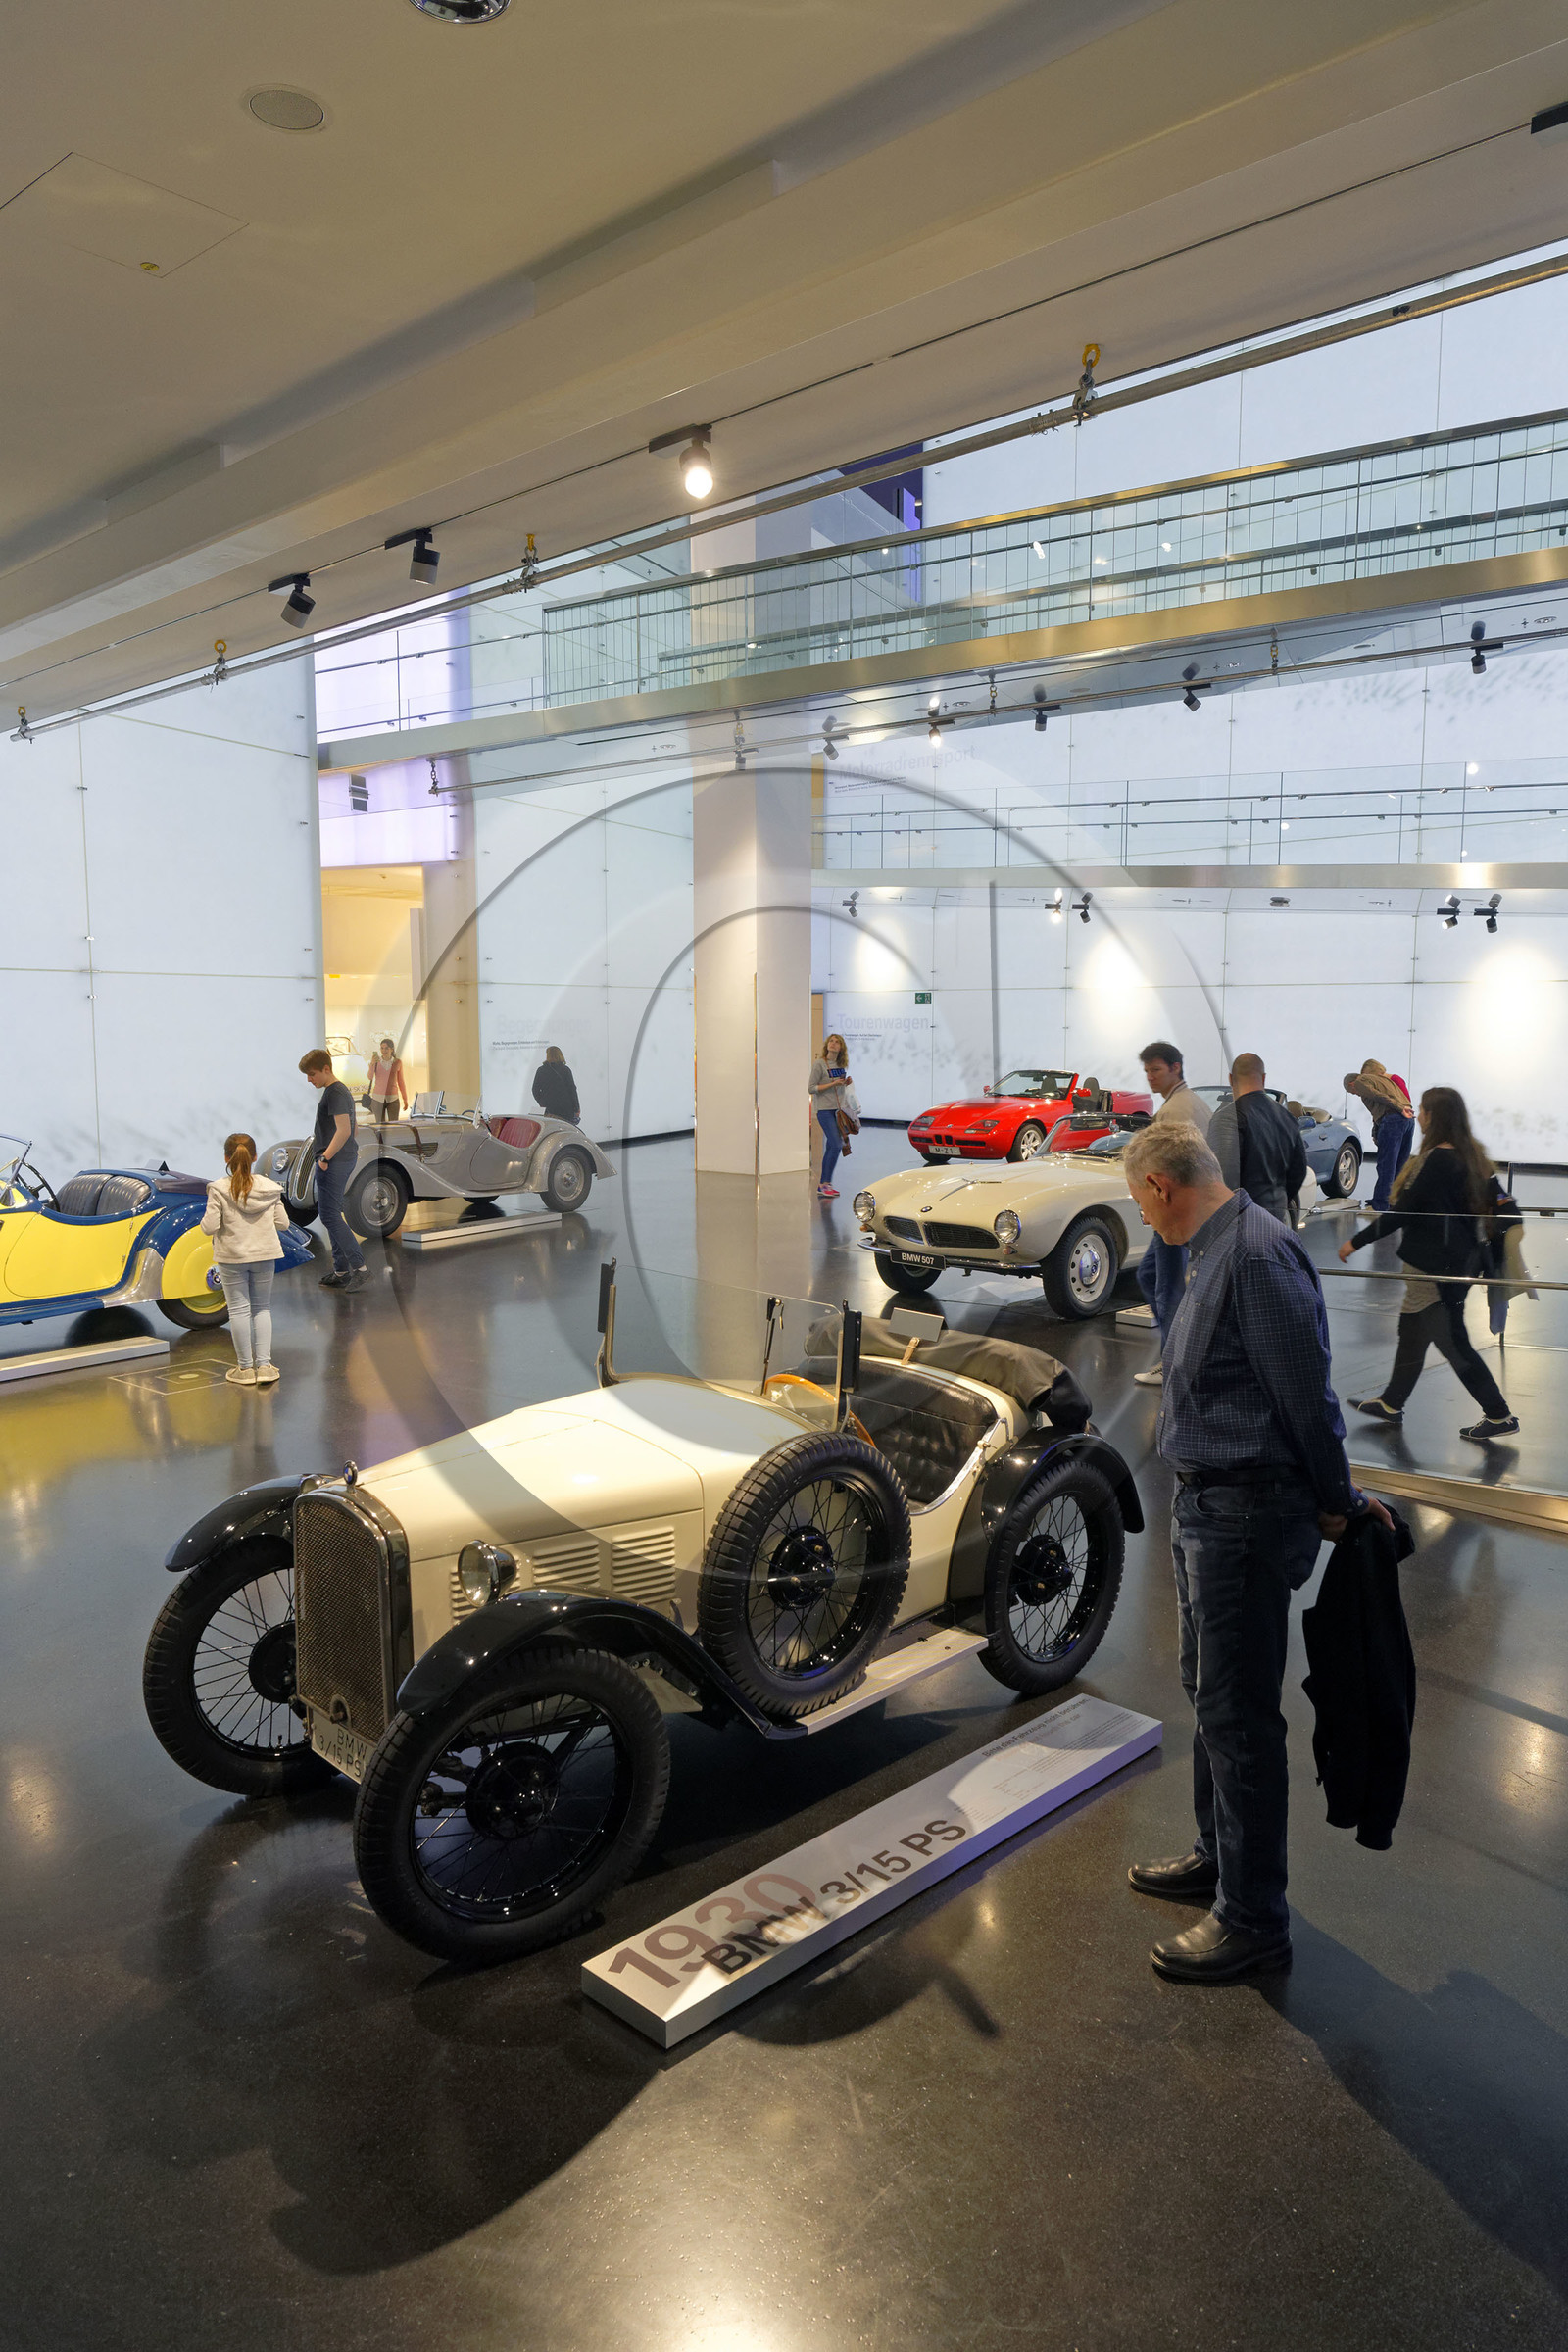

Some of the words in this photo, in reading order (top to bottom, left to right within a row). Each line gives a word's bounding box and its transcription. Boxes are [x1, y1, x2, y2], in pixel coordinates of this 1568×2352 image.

[838, 1013, 929, 1033] Tourenwagen
[902, 1252, 921, 1262] BMW
[921, 1255, 935, 1265] 507
[318, 1735, 342, 1765] 3/15
[346, 1753, 362, 1778] PS
[337, 1728, 368, 1760] BMW
[701, 1896, 828, 1975] BMW
[820, 1849, 912, 1905] 3/15
[899, 1819, 966, 1857] PS
[608, 1873, 816, 1988] 1930
